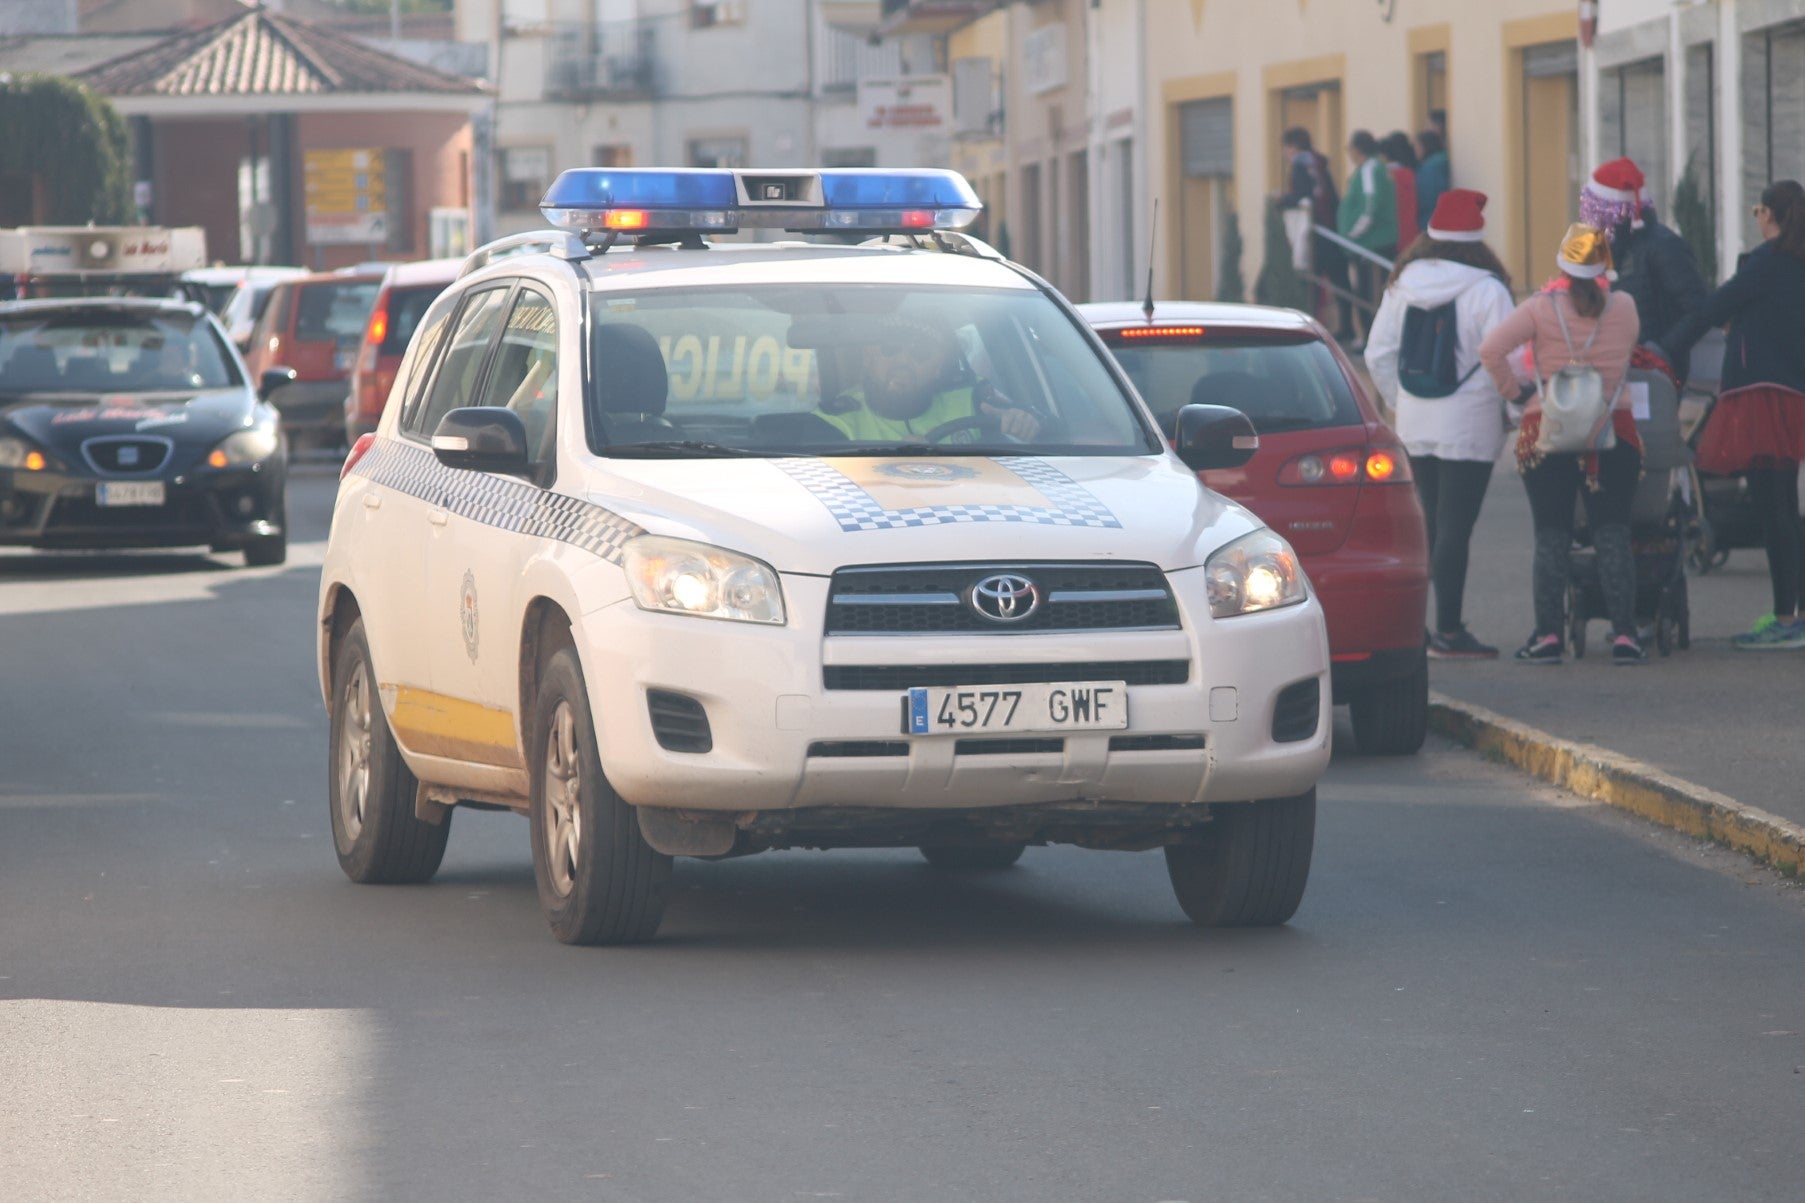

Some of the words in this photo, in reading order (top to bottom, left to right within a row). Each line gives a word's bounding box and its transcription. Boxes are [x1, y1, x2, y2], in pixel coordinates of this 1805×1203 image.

[916, 716, 924, 726] E
[937, 691, 1022, 728] 4577
[1048, 688, 1113, 723] GWF
